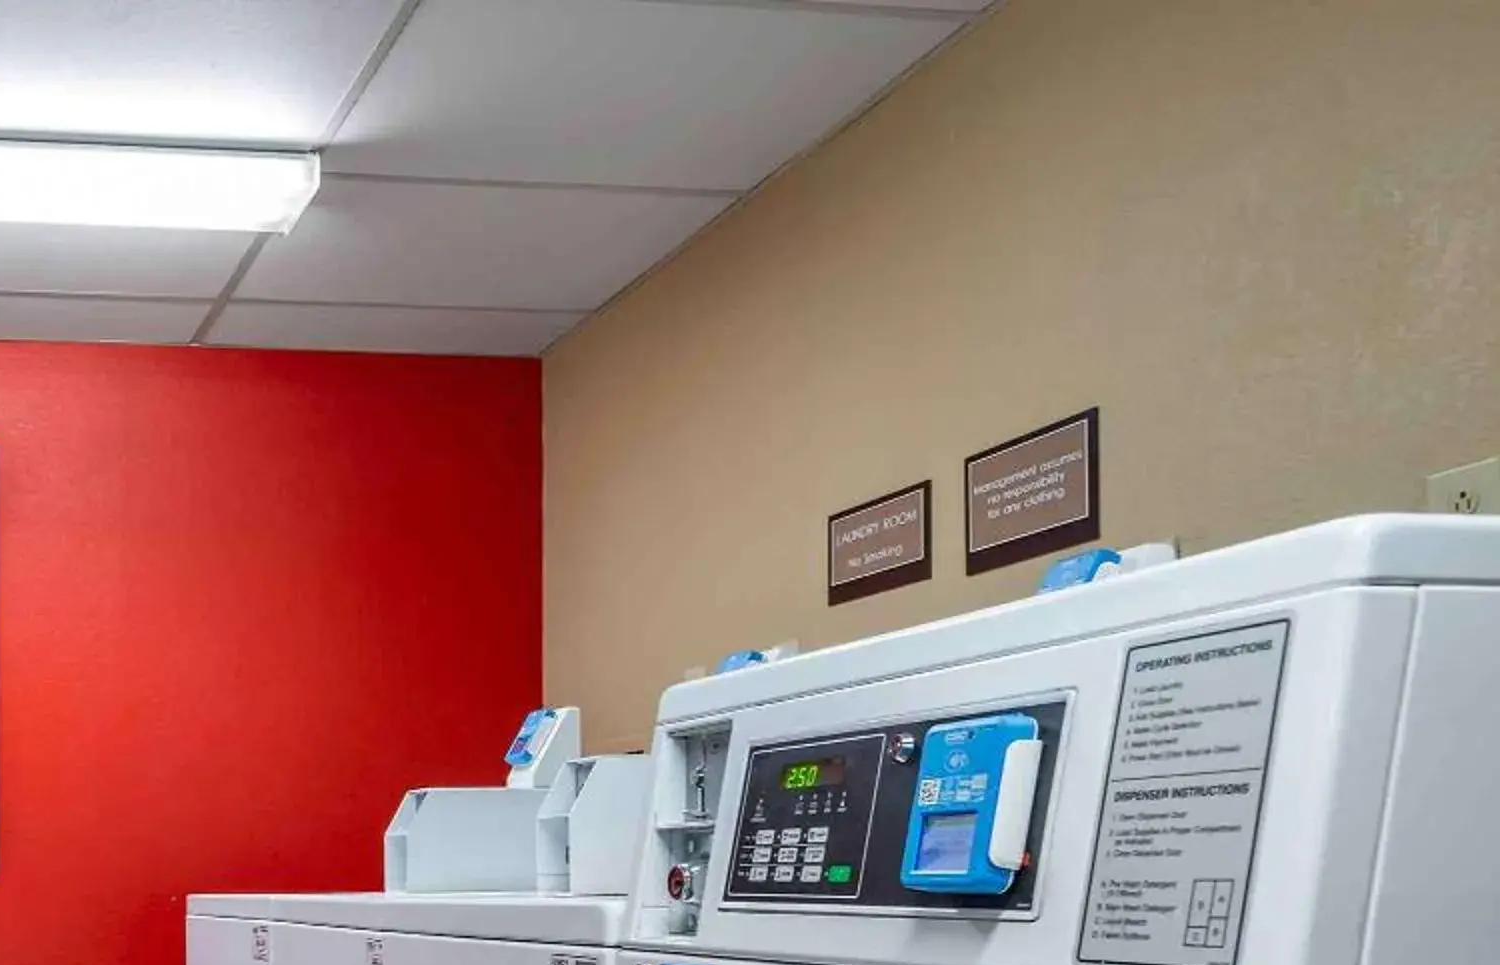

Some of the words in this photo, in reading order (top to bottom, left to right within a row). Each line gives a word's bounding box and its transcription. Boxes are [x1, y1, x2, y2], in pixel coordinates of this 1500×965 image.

[973, 464, 1037, 495] Management
[1003, 472, 1065, 499] responsibility
[1003, 501, 1021, 514] any
[1024, 487, 1066, 508] clothing
[836, 522, 879, 547] LAUNDRY
[883, 509, 917, 529] ROOM
[1136, 653, 1192, 673] OPERATING
[1194, 639, 1273, 663] INSTRUCTIONS
[1114, 787, 1169, 802] DISPENSER
[1171, 783, 1250, 799] INSTRUCTIONS
